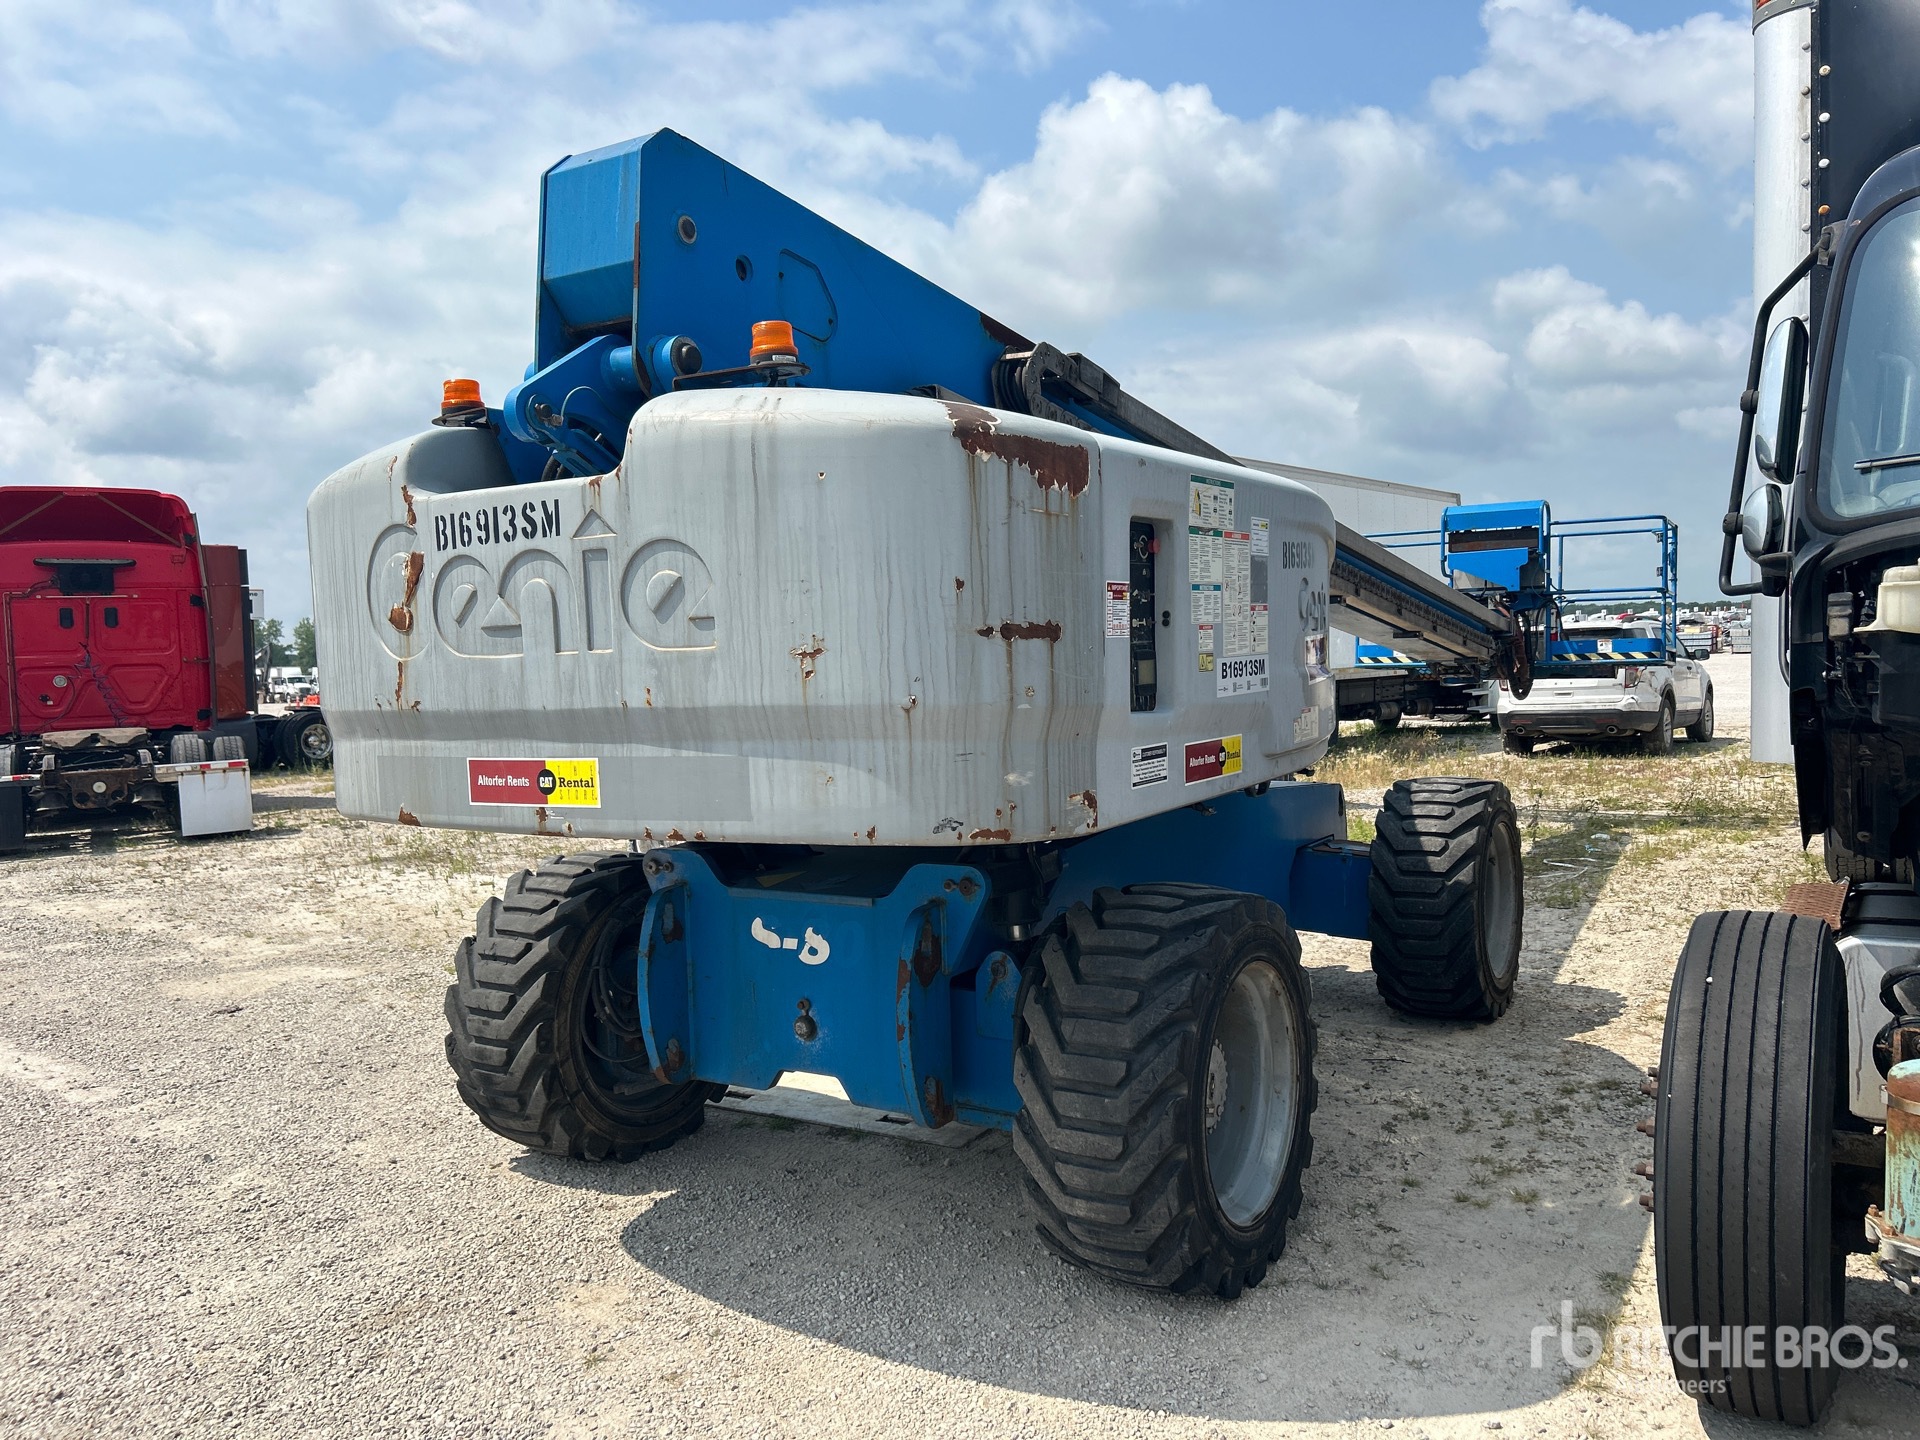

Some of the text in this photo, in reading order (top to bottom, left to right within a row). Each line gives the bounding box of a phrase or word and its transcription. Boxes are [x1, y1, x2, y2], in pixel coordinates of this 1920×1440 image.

[435, 499, 561, 551] B16913SM
[367, 506, 717, 662] Genie
[1221, 658, 1266, 680] B16913SM
[1205, 754, 1216, 764] Rents
[1226, 749, 1241, 760] Rental
[477, 774, 595, 788] Altorfer Rents CAT Rental
